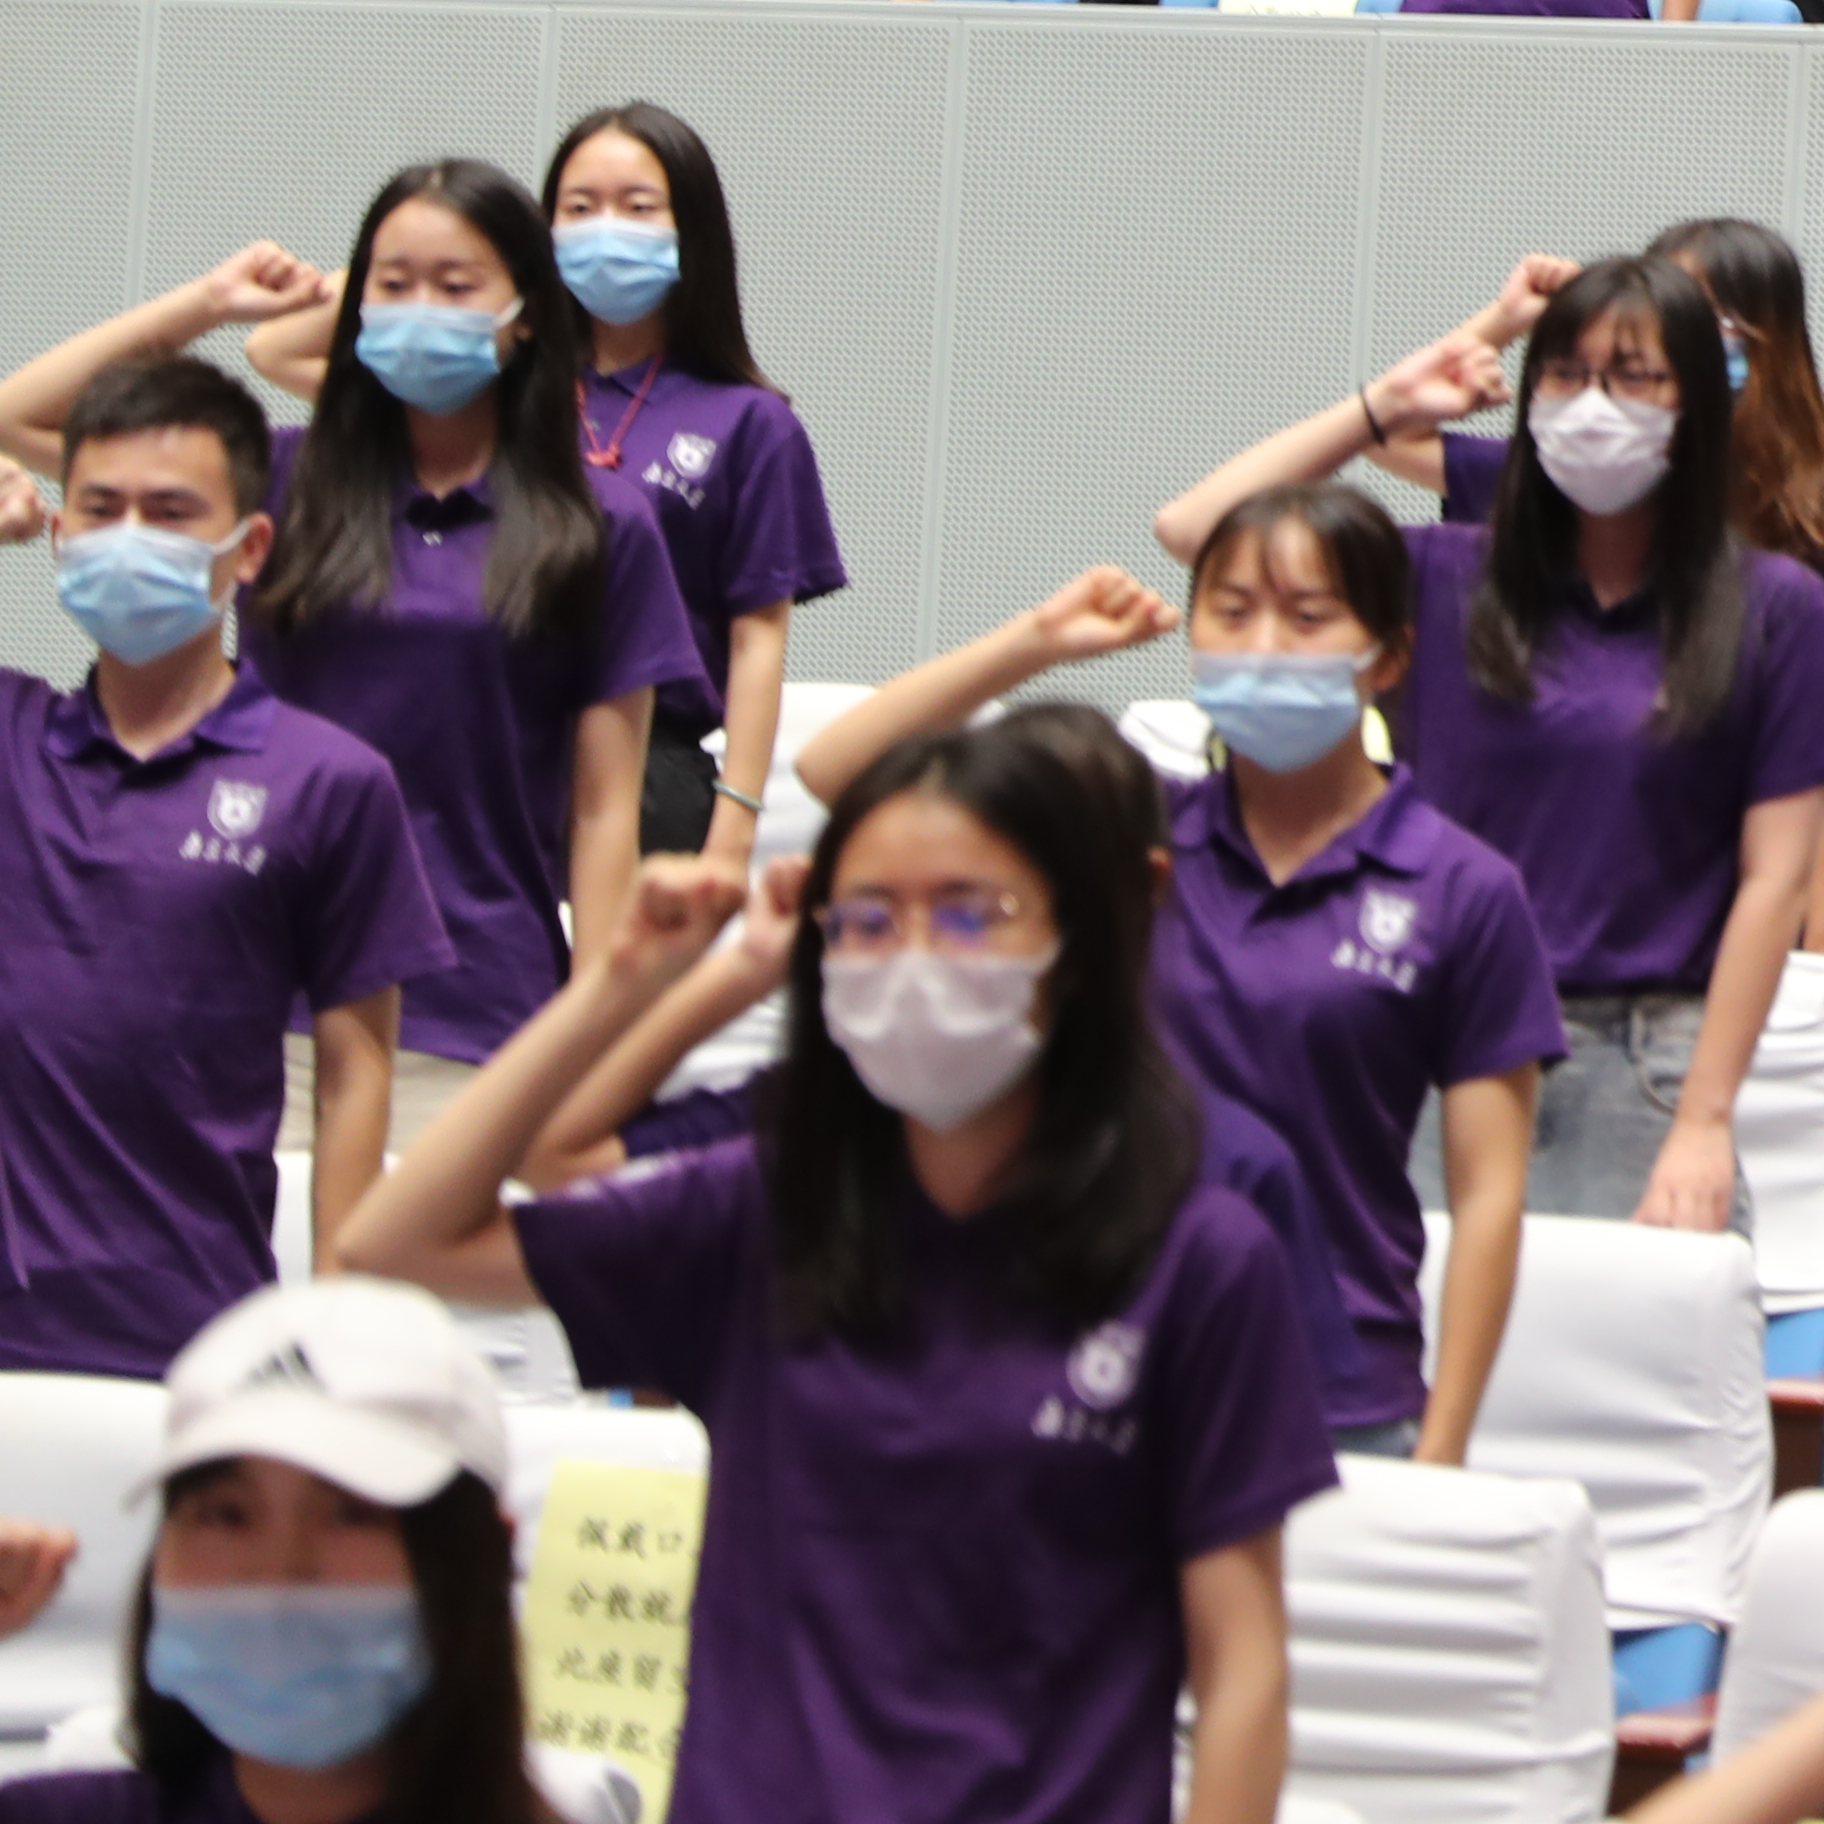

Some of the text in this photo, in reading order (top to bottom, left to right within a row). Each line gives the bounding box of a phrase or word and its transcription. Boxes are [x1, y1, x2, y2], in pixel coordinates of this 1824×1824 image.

[577, 1514, 684, 1561] 佩戴口
[568, 1578, 688, 1626] 分散就
